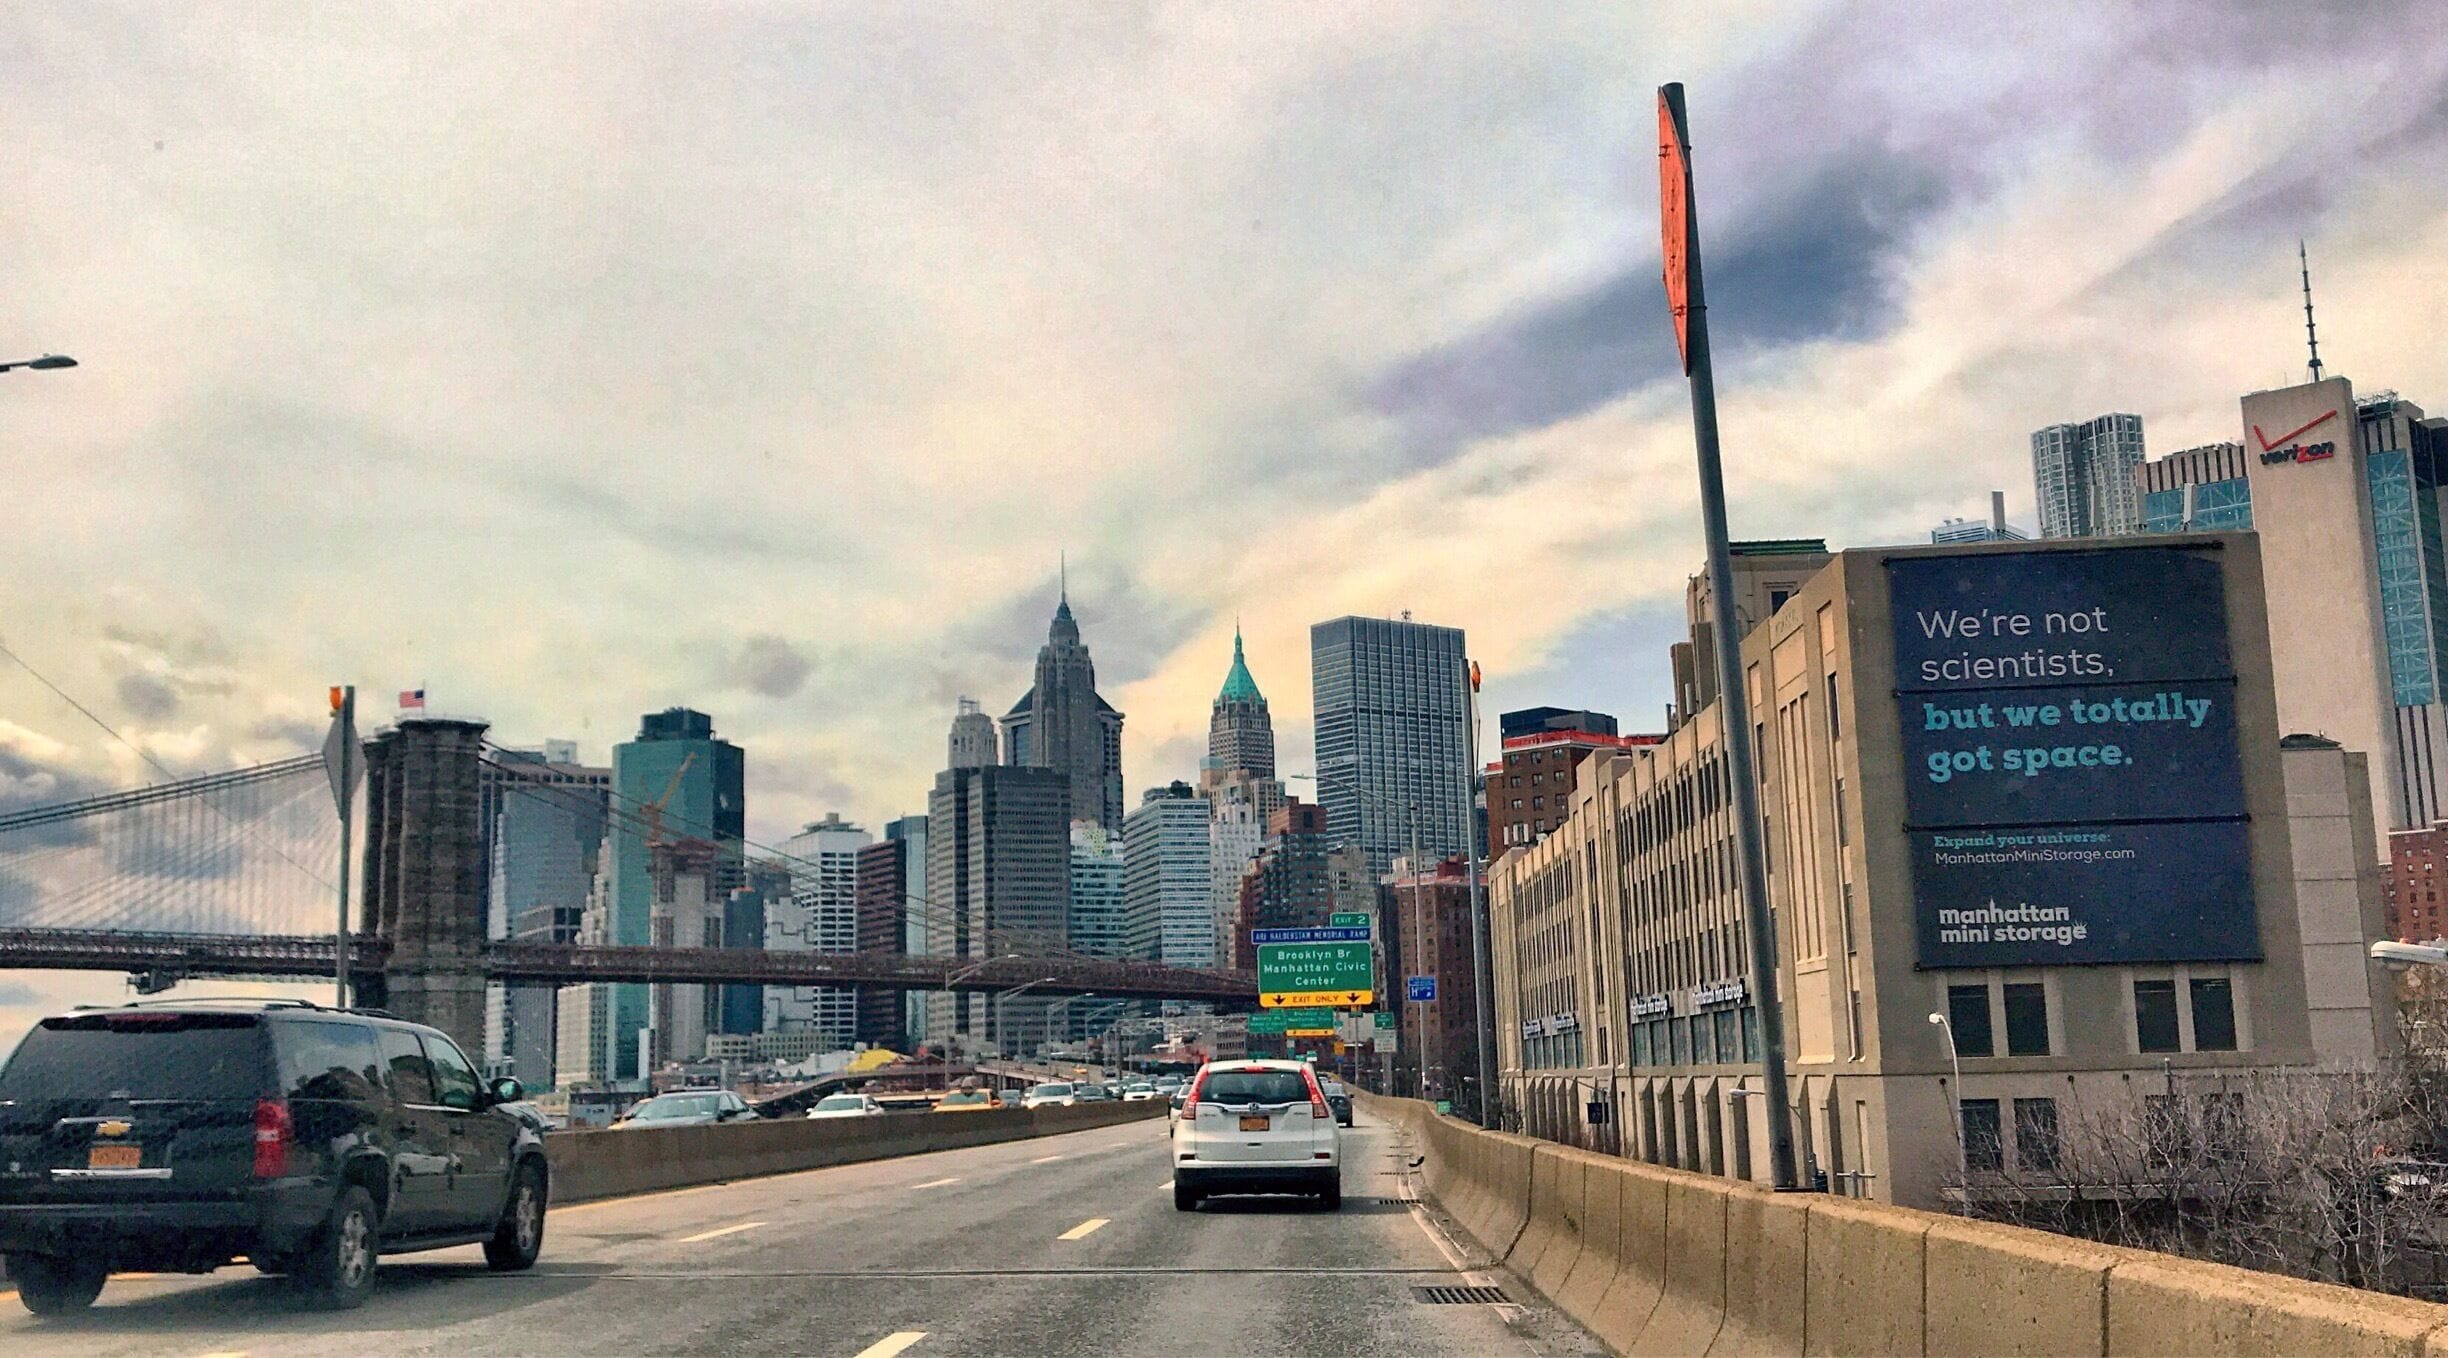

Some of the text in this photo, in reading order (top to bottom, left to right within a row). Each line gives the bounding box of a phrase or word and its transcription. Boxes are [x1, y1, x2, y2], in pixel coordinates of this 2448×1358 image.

[2260, 441, 2335, 465] verizon
[1916, 606, 2109, 640] We're not
[1921, 648, 2115, 682] scientists,
[1923, 691, 2213, 731] but we totally
[1927, 743, 2134, 784] got space.
[1933, 831, 2112, 850] Expand your universe:
[1935, 848, 2136, 865] ManhattanMiniStorage.com
[1357, 915, 1366, 925] 2
[1938, 897, 2071, 925] manhattan
[1350, 929, 1368, 938] RAMP
[1940, 919, 2089, 946] mini storage
[1277, 949, 1352, 961] Brooklyn Br
[1263, 961, 1367, 973] Manhattan Civic
[1295, 976, 1336, 986] Center
[1292, 995, 1340, 1004] EXIT ONLY
